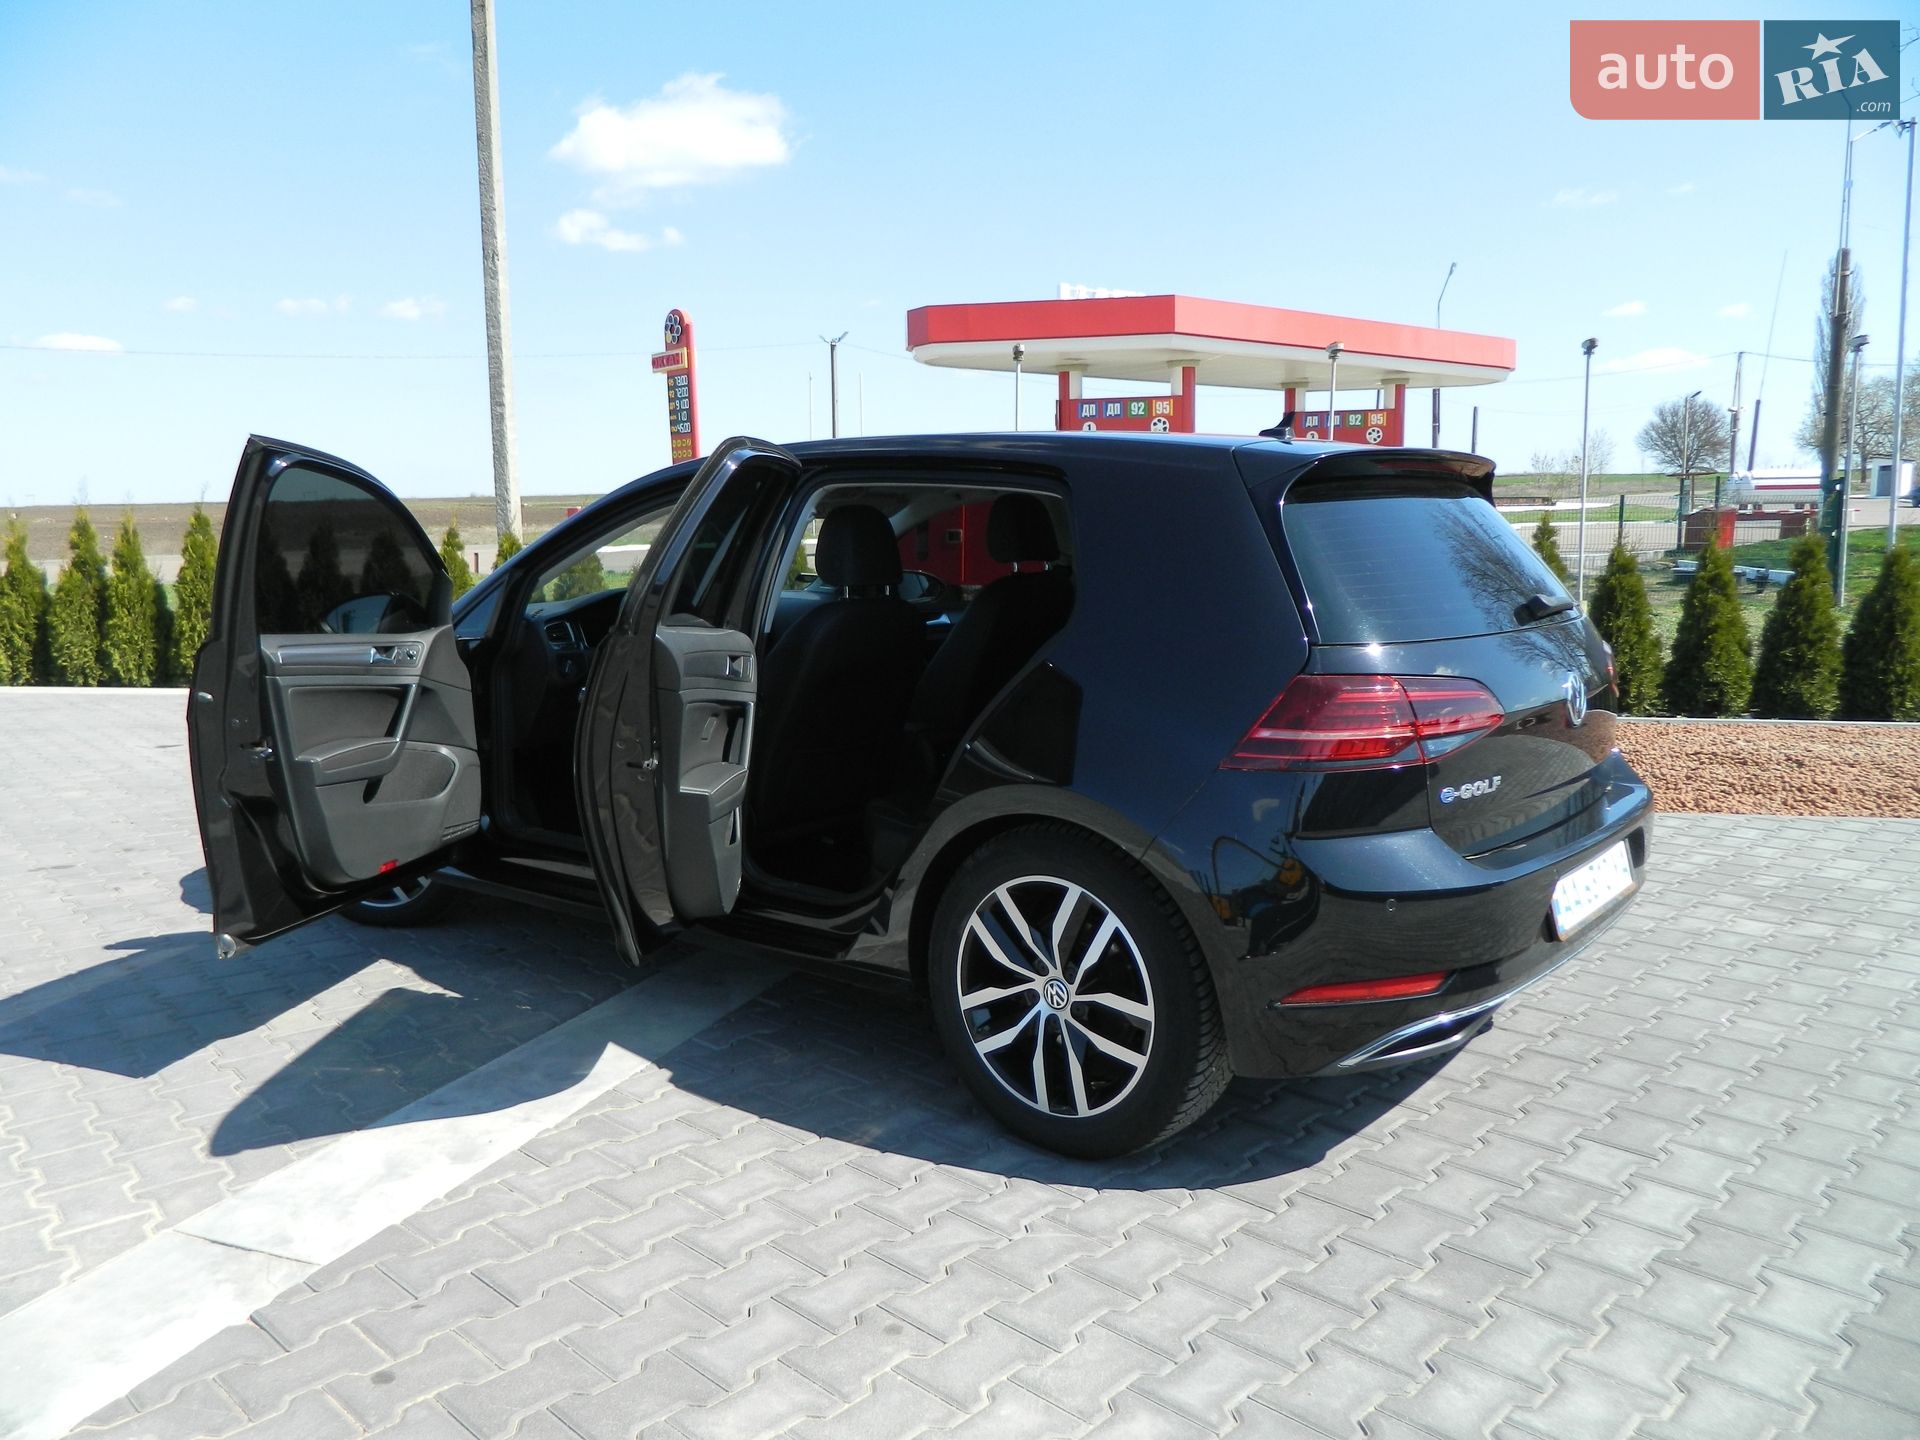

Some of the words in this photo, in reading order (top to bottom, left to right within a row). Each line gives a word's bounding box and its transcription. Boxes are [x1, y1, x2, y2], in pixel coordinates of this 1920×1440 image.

[1081, 404, 1096, 417] ДП
[1106, 402, 1121, 416] ДП
[1131, 402, 1145, 415] 92
[1156, 401, 1170, 414] 95
[1305, 416, 1319, 427] ДП
[1349, 414, 1362, 426] 92
[1371, 413, 1384, 425] 95
[1440, 775, 1502, 804] e-GOLF
